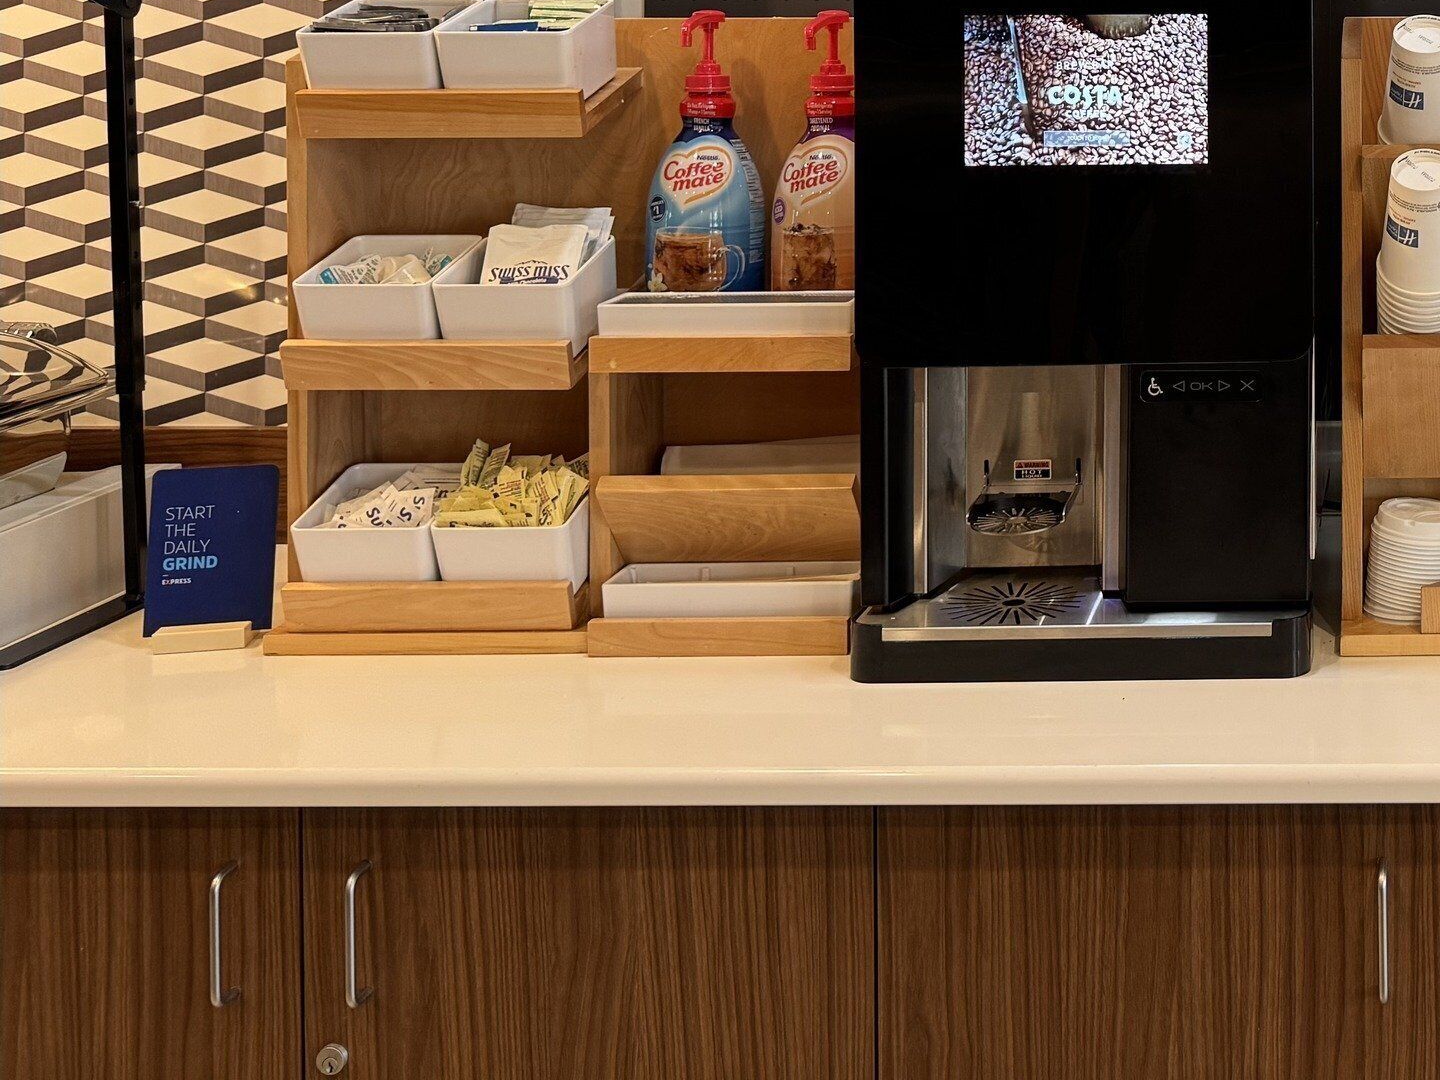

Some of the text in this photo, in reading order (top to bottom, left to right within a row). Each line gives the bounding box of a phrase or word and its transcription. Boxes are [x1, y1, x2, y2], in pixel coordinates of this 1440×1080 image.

[1046, 84, 1123, 111] COSTA
[663, 161, 725, 181] Coffee
[783, 160, 839, 183] Coffee
[672, 171, 726, 192] mate
[789, 170, 840, 194] mate
[488, 266, 532, 283] SWISS
[533, 264, 570, 281] MISS
[1189, 381, 1213, 391] OK
[165, 505, 216, 521] START
[165, 522, 197, 538] THE
[164, 538, 211, 555] DAILY
[162, 555, 218, 571] GRIND
[161, 577, 192, 586] EXPRESS
